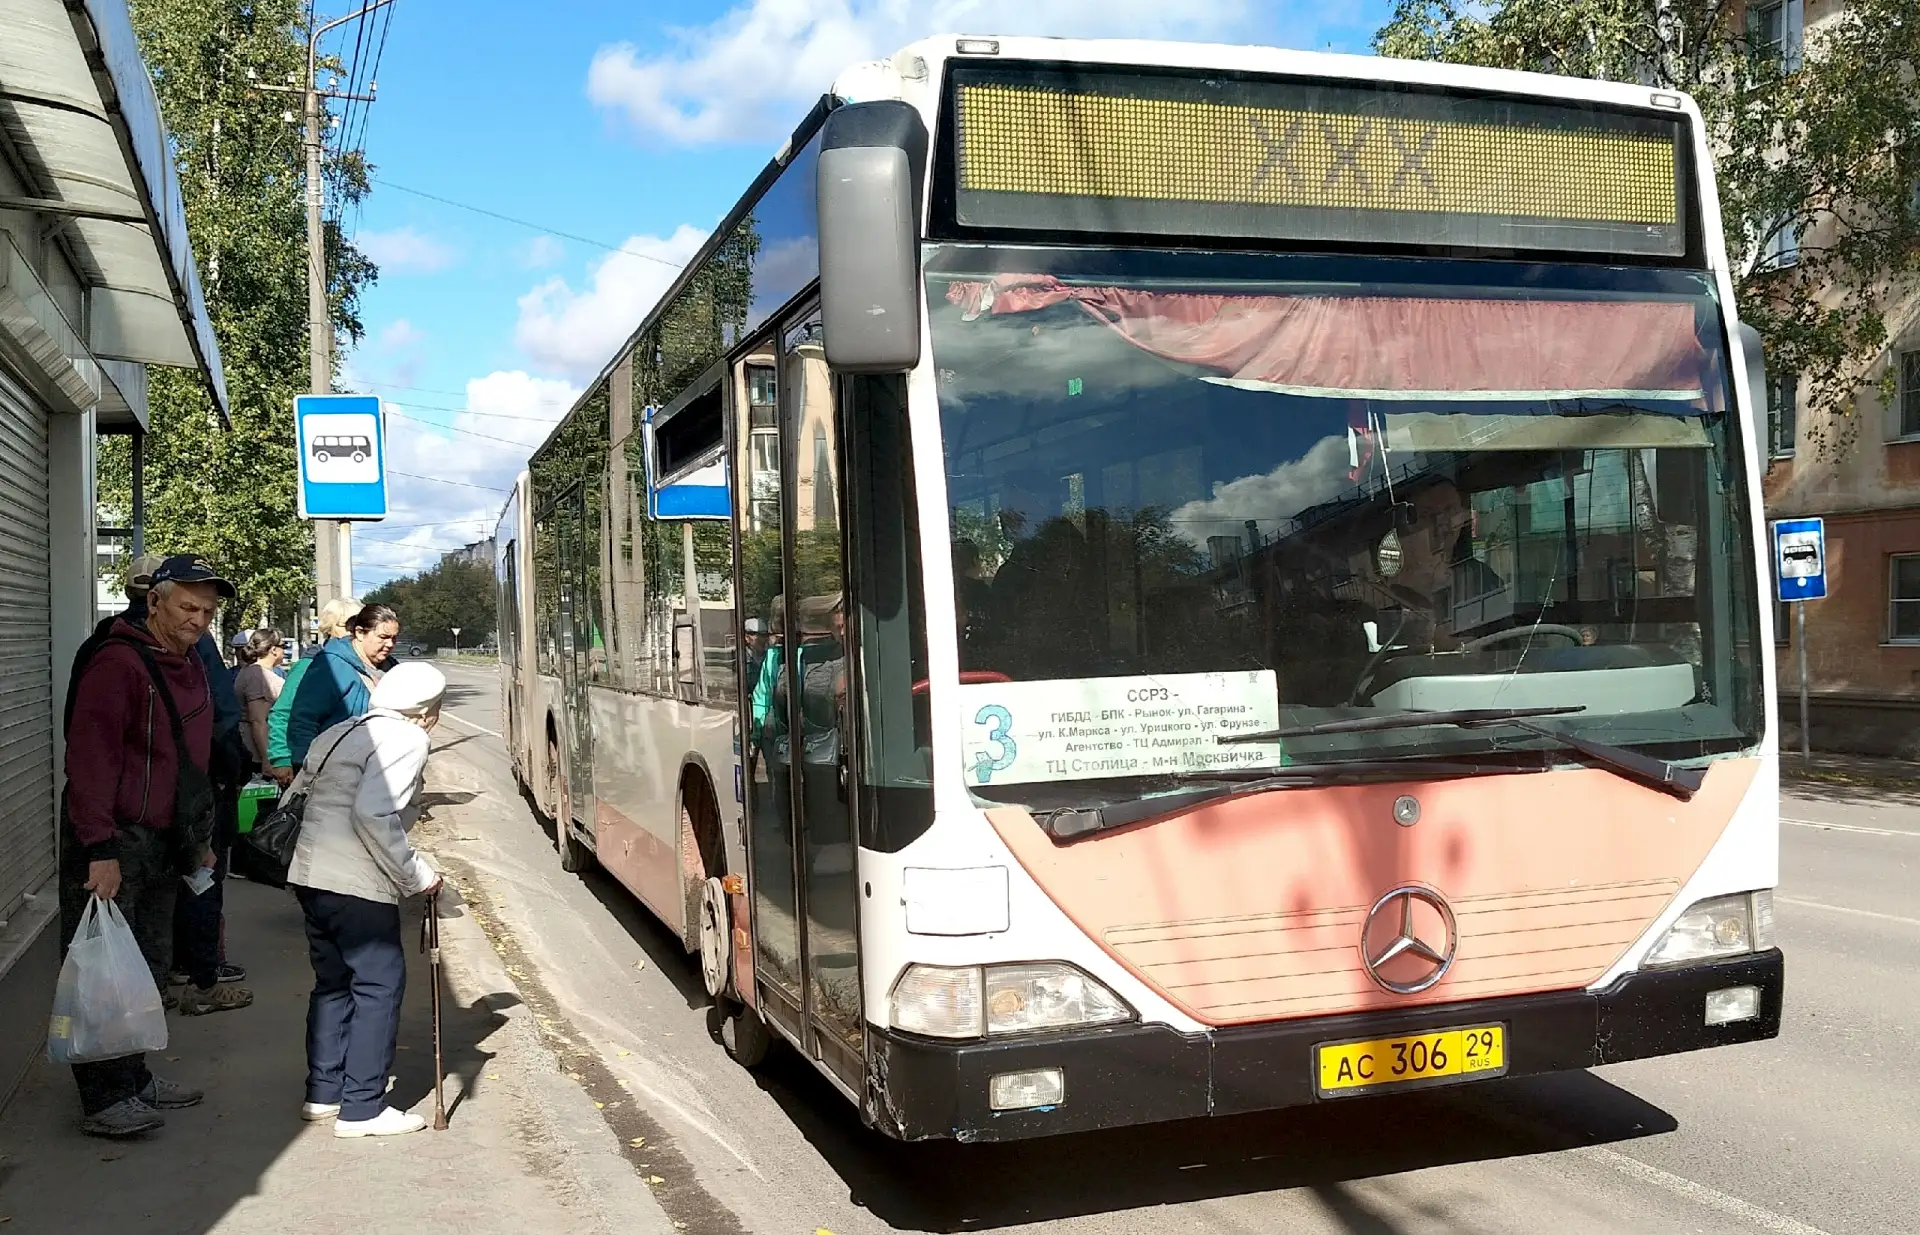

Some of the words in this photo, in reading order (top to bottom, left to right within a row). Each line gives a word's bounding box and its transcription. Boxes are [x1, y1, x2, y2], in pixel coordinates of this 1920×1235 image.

[1051, 711, 1091, 723] ГИБДД
[1101, 709, 1124, 721] БПК
[1178, 707, 1194, 718] ул.
[1197, 705, 1246, 715] Гагарина
[975, 704, 1017, 771] 3
[1038, 730, 1055, 741] ул.
[1058, 726, 1111, 740] К.Маркса
[1121, 725, 1137, 736] ул.
[1140, 722, 1191, 734] Урицкого
[1201, 721, 1217, 731] ул.
[1220, 719, 1260, 730] Фрунзе
[1065, 740, 1123, 752] Агентство
[1133, 738, 1148, 749] ТЦ
[1152, 737, 1202, 748] Адмирал
[1046, 760, 1067, 775] ТЦ
[1072, 757, 1138, 772] Столица
[1182, 750, 1263, 767] Москвичка
[1391, 1039, 1447, 1075] 306
[1466, 1031, 1493, 1057] 29
[1470, 1058, 1490, 1068] RUS
